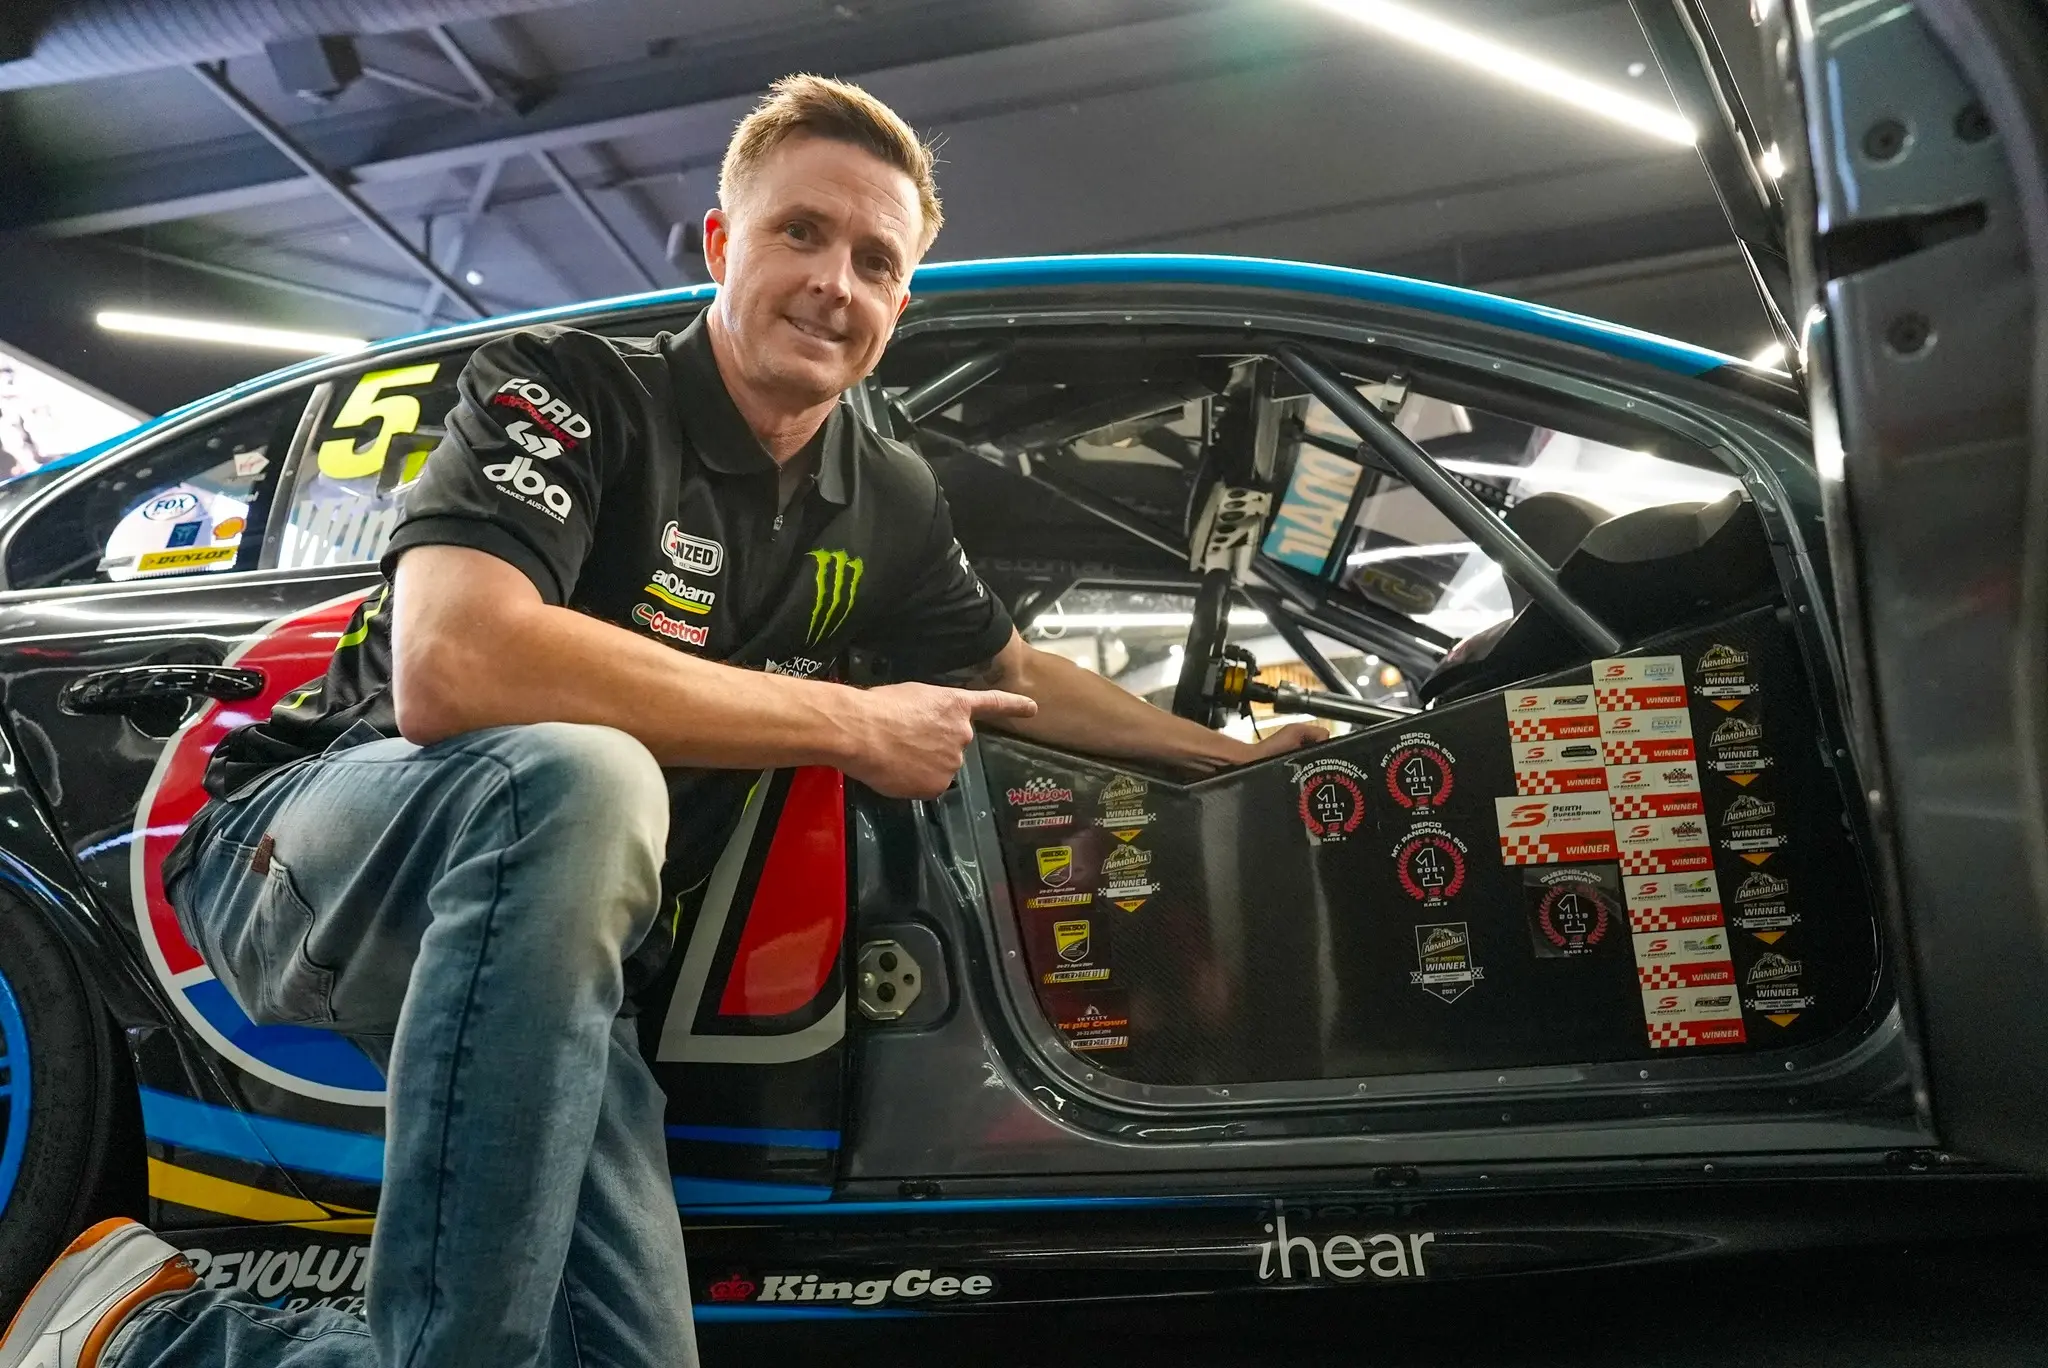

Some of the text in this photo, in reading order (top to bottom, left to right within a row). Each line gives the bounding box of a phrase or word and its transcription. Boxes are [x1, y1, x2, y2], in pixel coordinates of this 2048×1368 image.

[498, 378, 591, 438] FORD
[482, 455, 572, 518] dba
[153, 497, 188, 512] FOX
[526, 498, 565, 525] AUSTRALIA
[156, 549, 231, 565] DUNLOP
[650, 610, 709, 647] Castrol
[1705, 676, 1745, 685] WINNER
[1646, 696, 1683, 705] WINNER
[1559, 726, 1594, 735] WINNER
[1400, 732, 1431, 742] REPCO
[1380, 738, 1456, 768] MT. PANORAMA 500
[1653, 748, 1690, 757] WINNER
[1718, 750, 1760, 759] WINNER
[1290, 758, 1368, 784] WD-40 TOWNSVILLE
[1300, 764, 1359, 783] SUPERSPRINT
[1566, 777, 1602, 787] WINNER
[1552, 804, 1582, 812] PERTH
[1662, 802, 1698, 812] WINNER
[1106, 808, 1144, 818] WINNER
[1410, 821, 1442, 830] REPCO
[1732, 828, 1773, 838] WINNER
[1391, 828, 1468, 858] MT. PANORAMA 500
[1566, 844, 1610, 855] WINNER
[1671, 856, 1708, 866] WINNER
[1540, 868, 1602, 884] QUEENSLAND
[1547, 874, 1595, 886] RACEWAY
[1109, 878, 1148, 888] WINNER
[1744, 906, 1786, 916] WINNER
[1682, 914, 1718, 924] WINNER
[1425, 962, 1467, 972] WINNER
[1692, 972, 1728, 982] WINNER
[1756, 988, 1800, 998] WINNER
[1092, 1019, 1128, 1028] Crown
[1702, 1029, 1740, 1039] WINNER
[1258, 1216, 1435, 1280] ihear
[757, 1269, 993, 1305] KingGee
